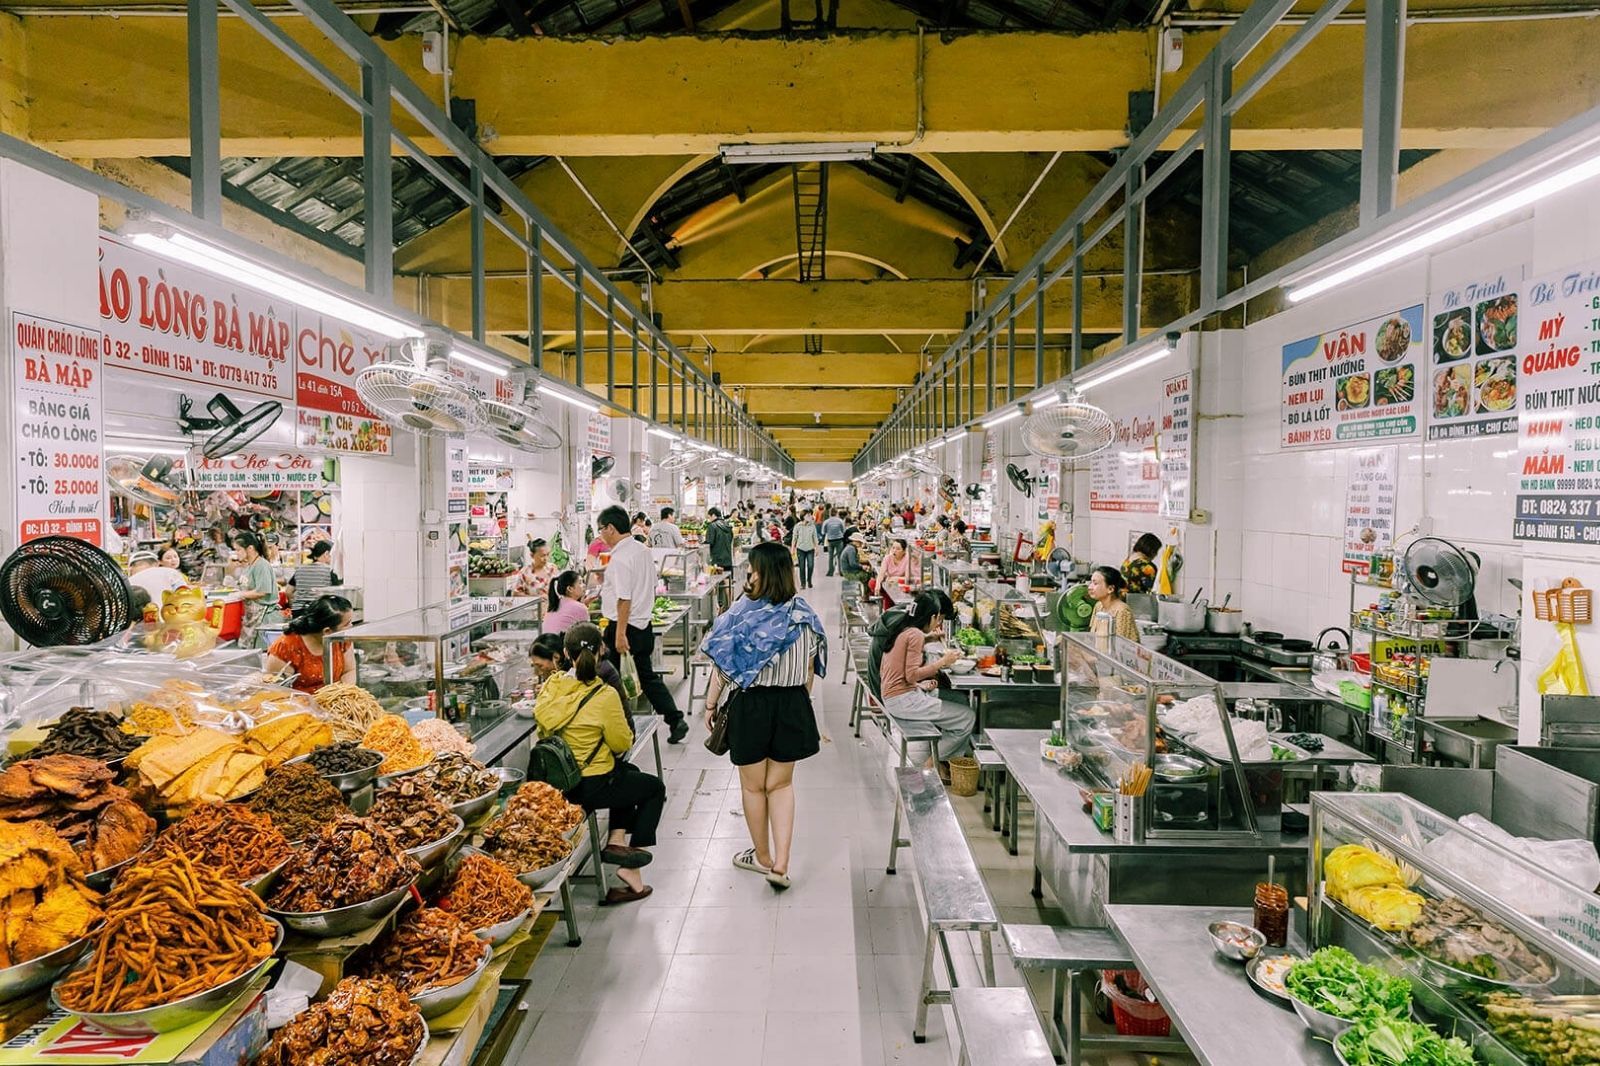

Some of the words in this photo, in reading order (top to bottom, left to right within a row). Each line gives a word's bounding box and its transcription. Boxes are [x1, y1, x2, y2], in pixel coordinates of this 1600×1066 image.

[1464, 275, 1505, 302] Trinh
[138, 268, 207, 342] LÒNG
[213, 293, 244, 353] BÀ
[249, 305, 289, 372] MẬP
[17, 321, 45, 350] QUÁN
[48, 328, 73, 355] CHÁO
[75, 331, 98, 360] LÒNG
[1323, 331, 1366, 363] VÂN
[115, 340, 131, 360] 32
[142, 344, 169, 369] ĐÌNH
[173, 354, 192, 373] 15A
[203, 359, 217, 378] ĐT:
[219, 366, 242, 383] 0779
[244, 371, 260, 387] 417
[262, 374, 277, 389] 375
[1522, 343, 1580, 376] QUẢNG
[25, 354, 51, 382] BÀ
[56, 360, 93, 392] MẬP
[1288, 370, 1306, 387] BÚN
[1308, 367, 1327, 383] THỊT
[1329, 359, 1365, 378] NƯỚNG
[1288, 392, 1308, 406] NEM
[1310, 388, 1324, 405] LỤI
[1525, 389, 1547, 410] BÚN
[1551, 387, 1574, 410] THỊT
[29, 396, 66, 417] BẢNG
[69, 403, 90, 420] GIÁ
[1314, 403, 1331, 421] LỐT
[22, 421, 60, 440] CHÁO
[64, 424, 97, 442] LÒNG
[1467, 424, 1480, 436] 15A
[1575, 416, 1592, 430] HEO
[1288, 430, 1311, 444] BÁNH
[1313, 427, 1331, 441] XÈO
[1574, 438, 1592, 451] HEO
[28, 447, 48, 467] TÔ:
[231, 453, 269, 471] Chợ
[275, 453, 314, 470] Cồn
[1574, 460, 1594, 472] NEM
[29, 475, 48, 495] TÔ:
[252, 473, 270, 482] SINH
[1539, 479, 1556, 490] BANK
[1577, 479, 1592, 490] 0824
[1522, 499, 1538, 514] ĐT:
[1540, 499, 1567, 515] 0824
[1569, 500, 1592, 516] 337
[51, 523, 60, 533] 32
[84, 521, 97, 532] 15A
[1515, 520, 1525, 536] LÔ
[1526, 524, 1536, 537] 04
[1537, 521, 1558, 538] ĐÌNH
[1559, 525, 1576, 540] 15A
